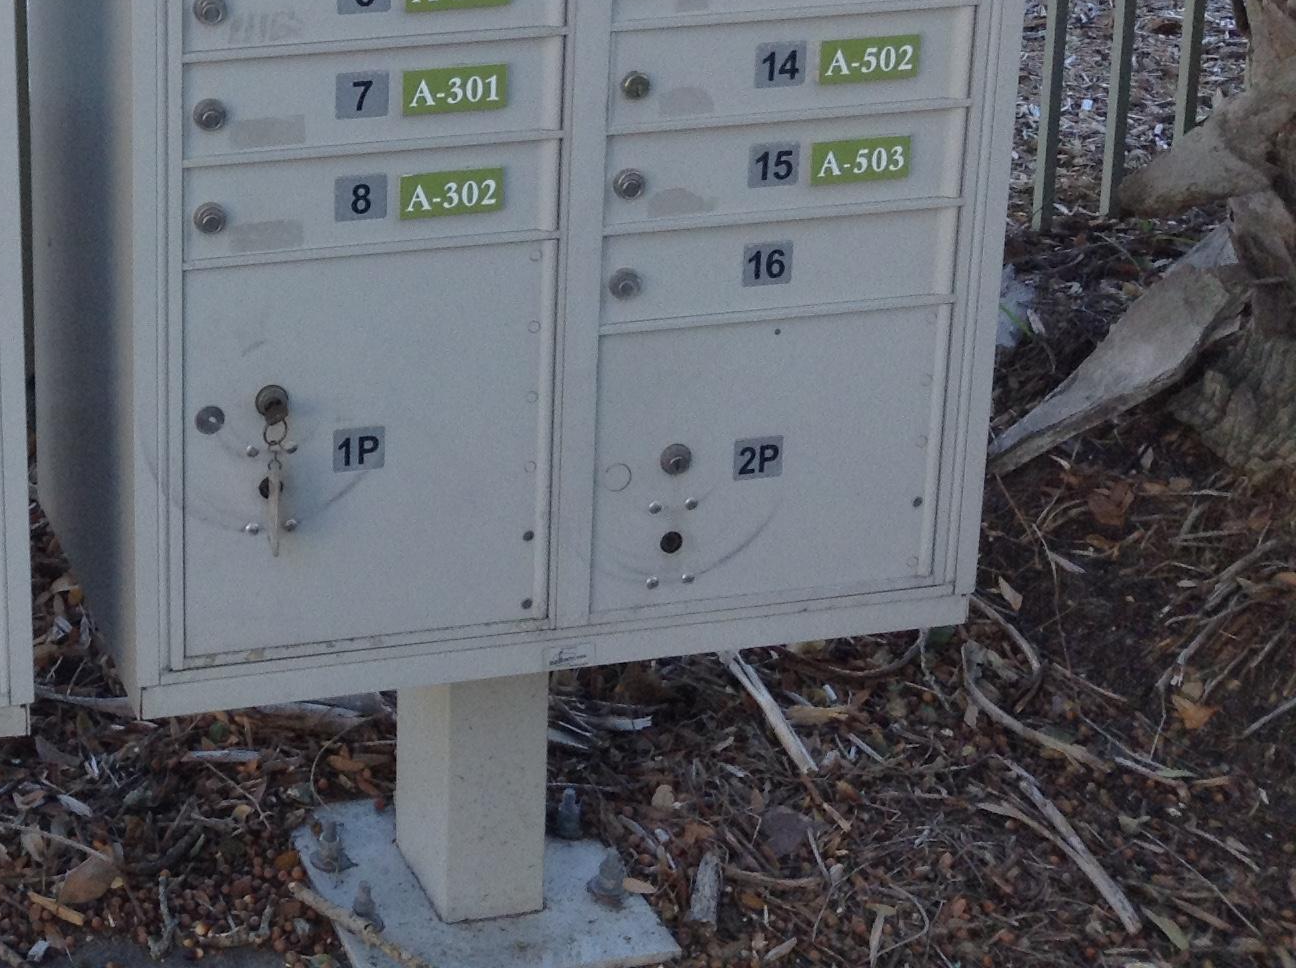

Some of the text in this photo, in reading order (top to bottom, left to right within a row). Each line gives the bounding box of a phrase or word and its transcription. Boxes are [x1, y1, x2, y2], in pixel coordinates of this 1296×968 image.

[762, 49, 800, 82] 14
[824, 44, 914, 76] A-502
[352, 80, 374, 112] 7
[409, 74, 499, 107] A-301
[755, 150, 794, 181] 15
[817, 145, 905, 177] A-503
[350, 183, 372, 215] 8
[406, 179, 497, 212] A-302
[748, 248, 786, 280] 16
[337, 435, 380, 467] 1P
[737, 443, 780, 476] 2P
